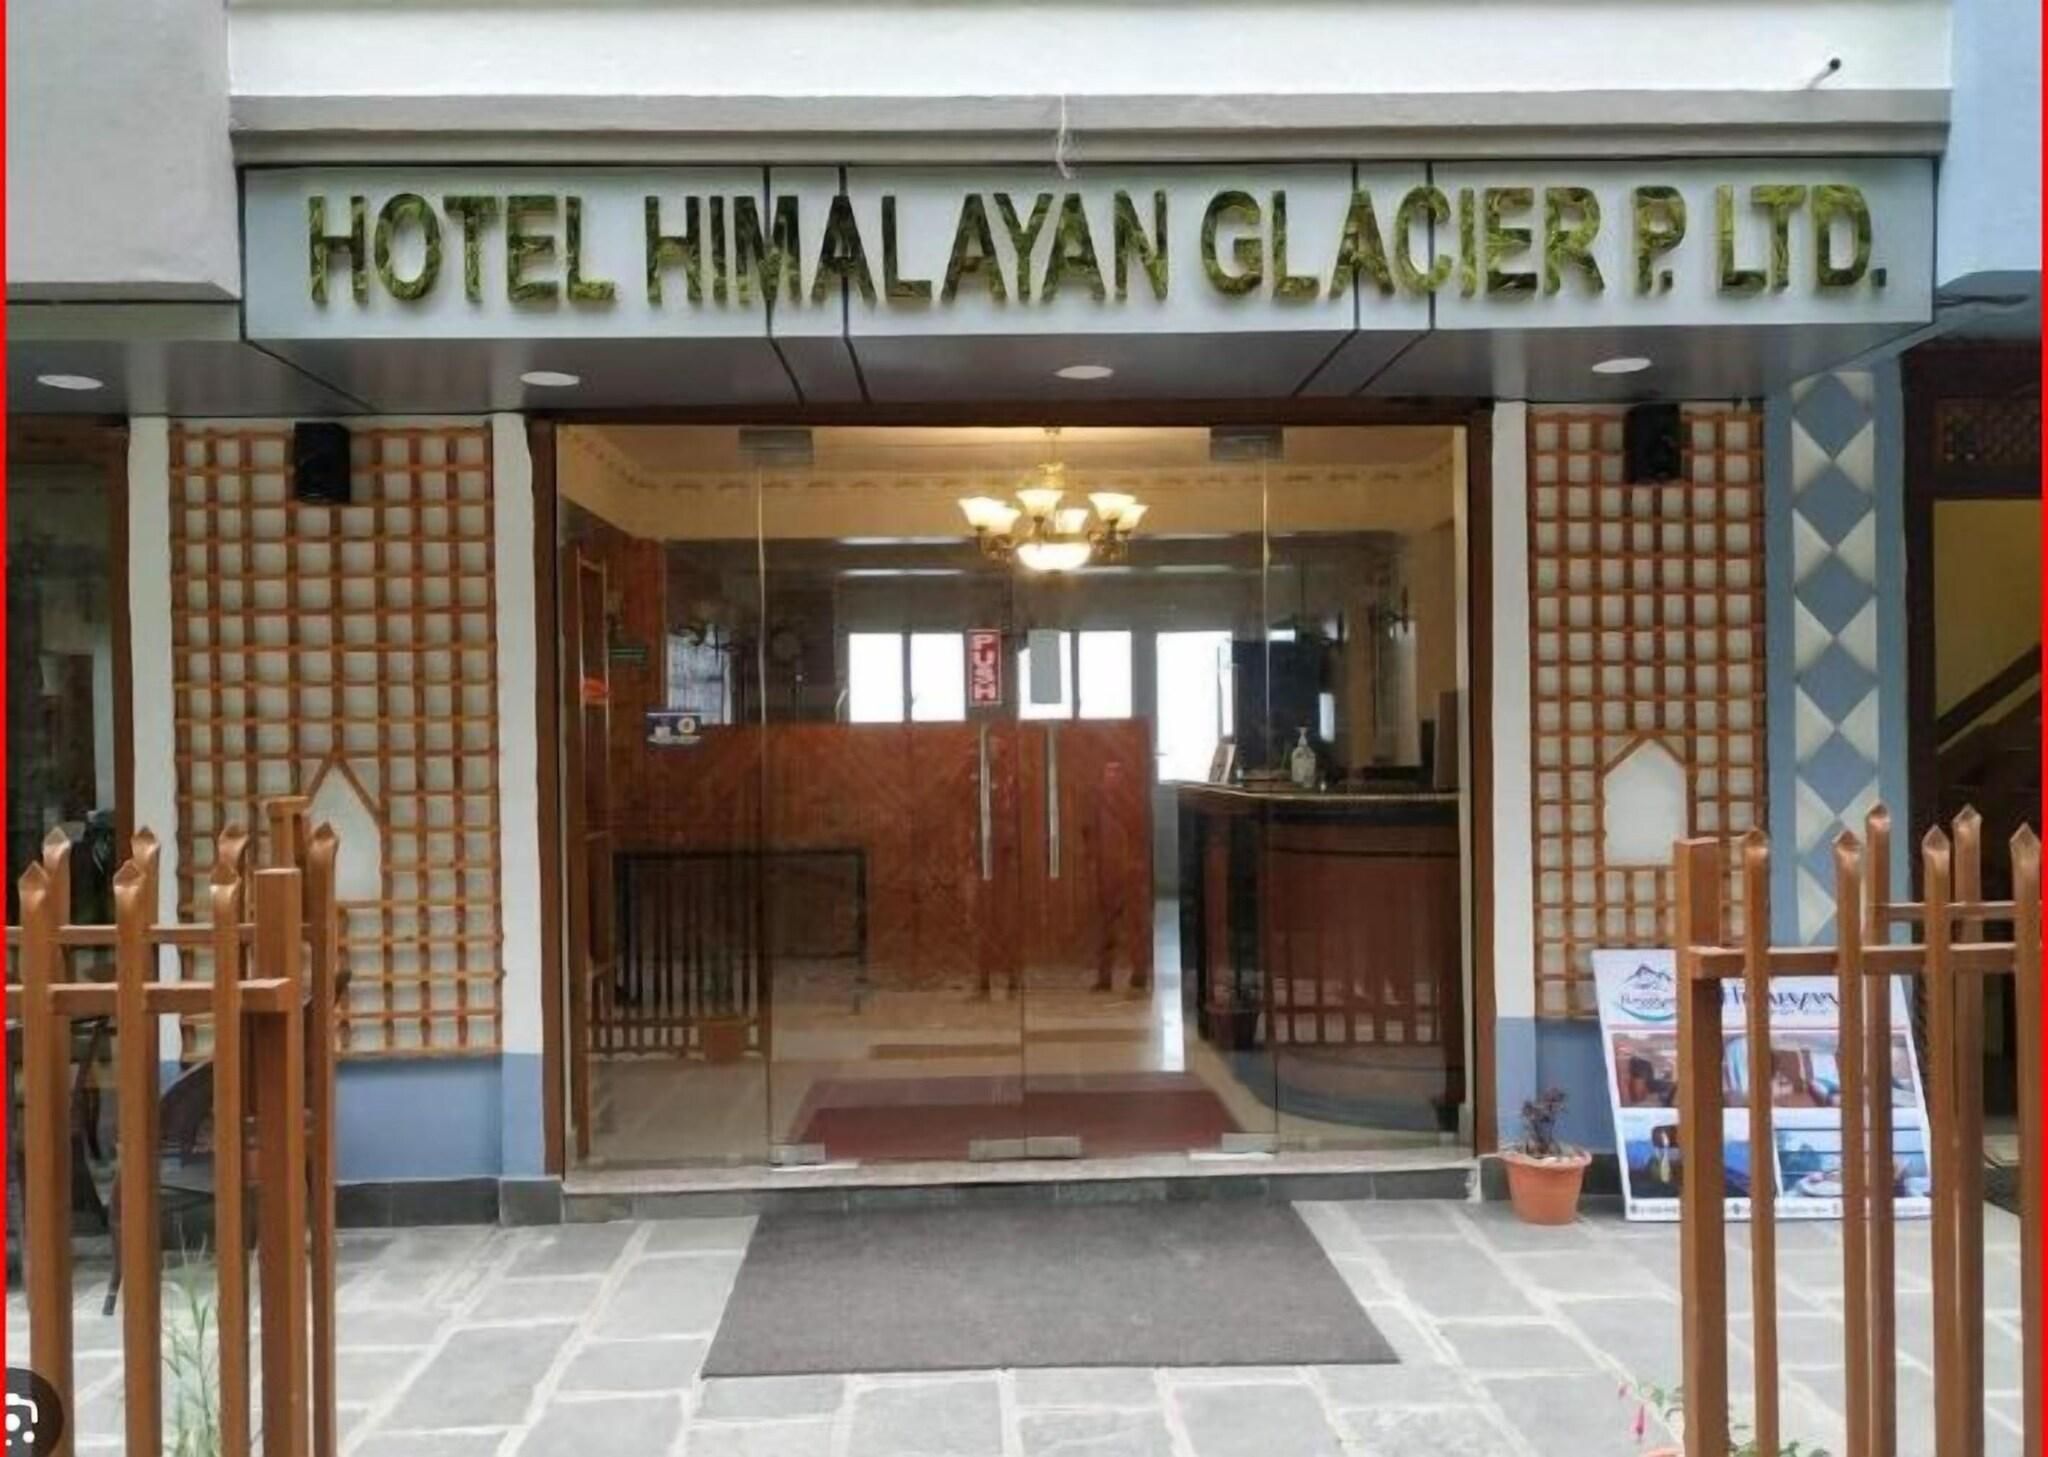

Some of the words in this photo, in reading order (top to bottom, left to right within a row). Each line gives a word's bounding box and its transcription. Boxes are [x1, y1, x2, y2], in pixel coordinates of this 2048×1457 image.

[308, 193, 617, 306] HOTEL
[645, 191, 1170, 304] HIMALAYAN
[1201, 185, 1607, 298] GLACIER
[1634, 185, 1689, 295] P.
[1716, 184, 1888, 293] LTD.
[973, 634, 996, 700] PUSH
